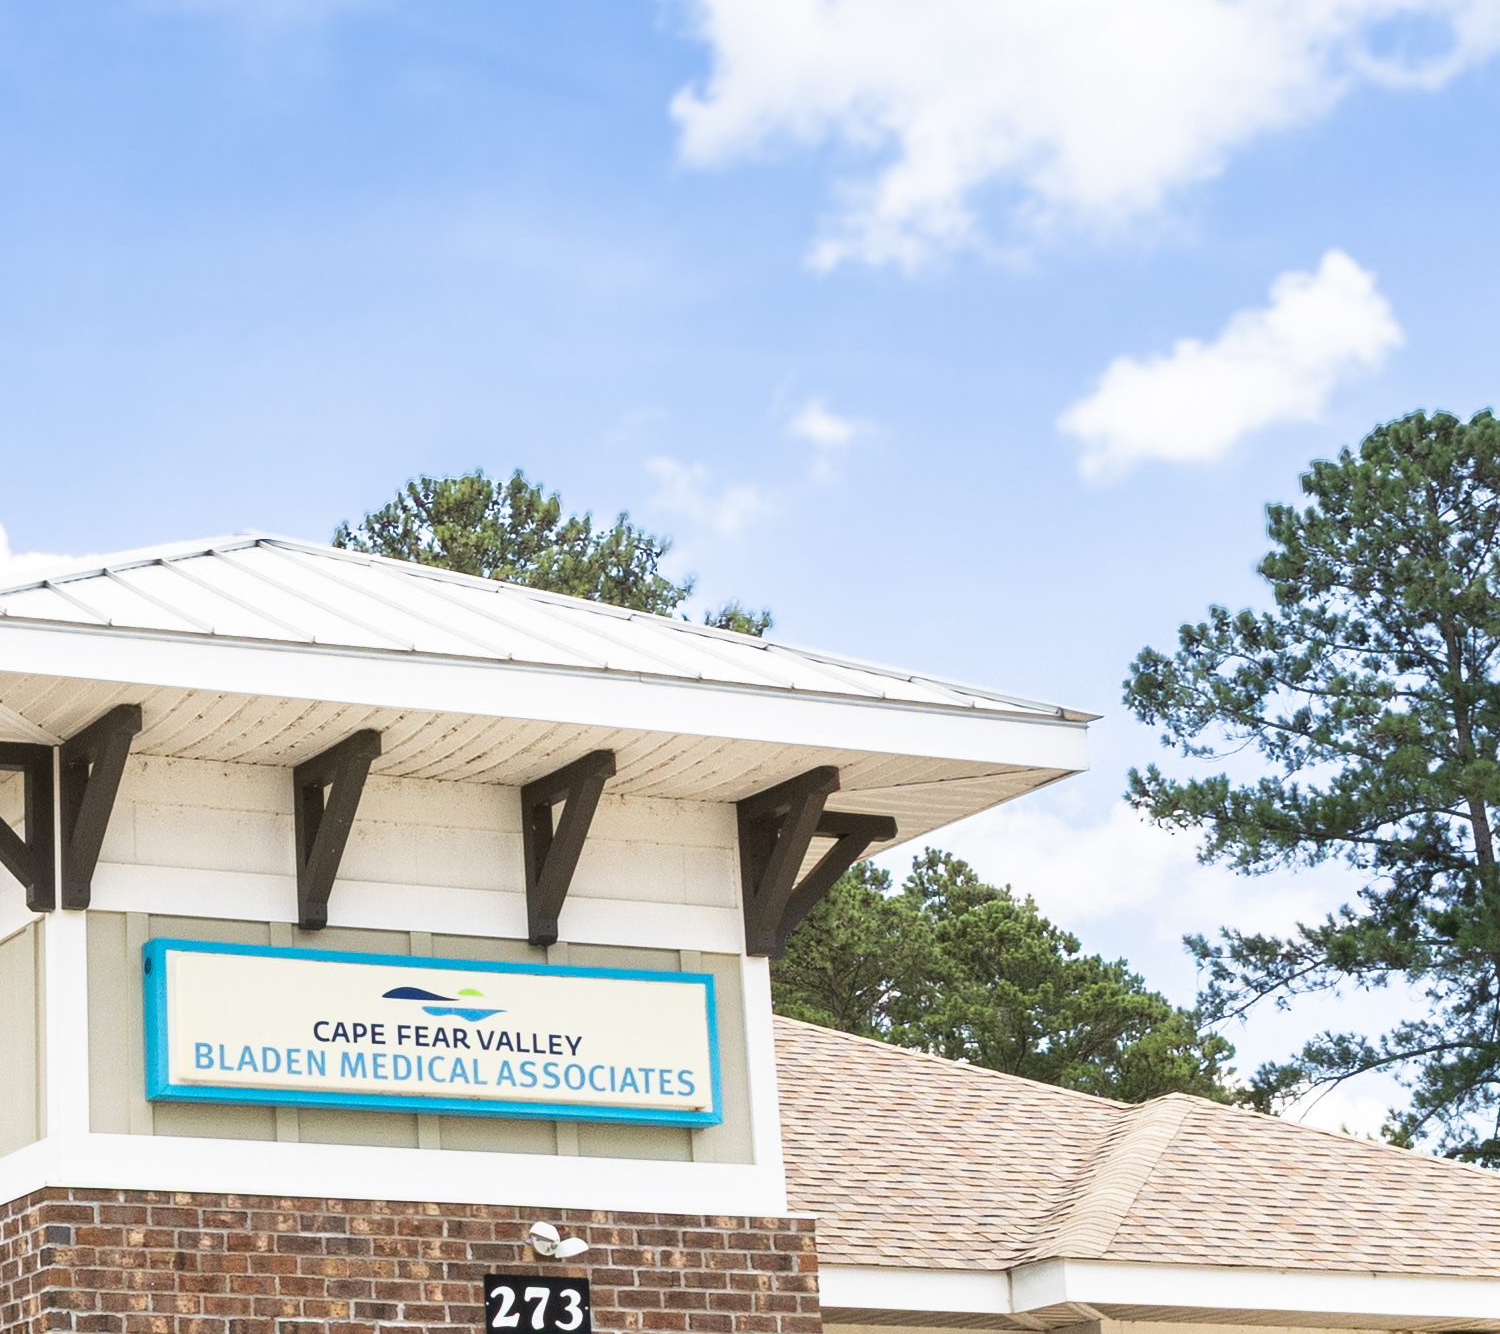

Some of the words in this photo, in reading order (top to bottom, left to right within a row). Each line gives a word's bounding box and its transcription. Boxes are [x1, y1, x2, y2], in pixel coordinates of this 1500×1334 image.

[313, 1020, 386, 1046] CAPE
[397, 1024, 471, 1051] FEAR
[477, 1029, 583, 1057] VALLEY
[194, 1042, 327, 1078] BLADEN
[340, 1050, 488, 1086] MEDICAL
[496, 1058, 696, 1097] ASSOCIATES
[489, 1285, 585, 1332] 273
